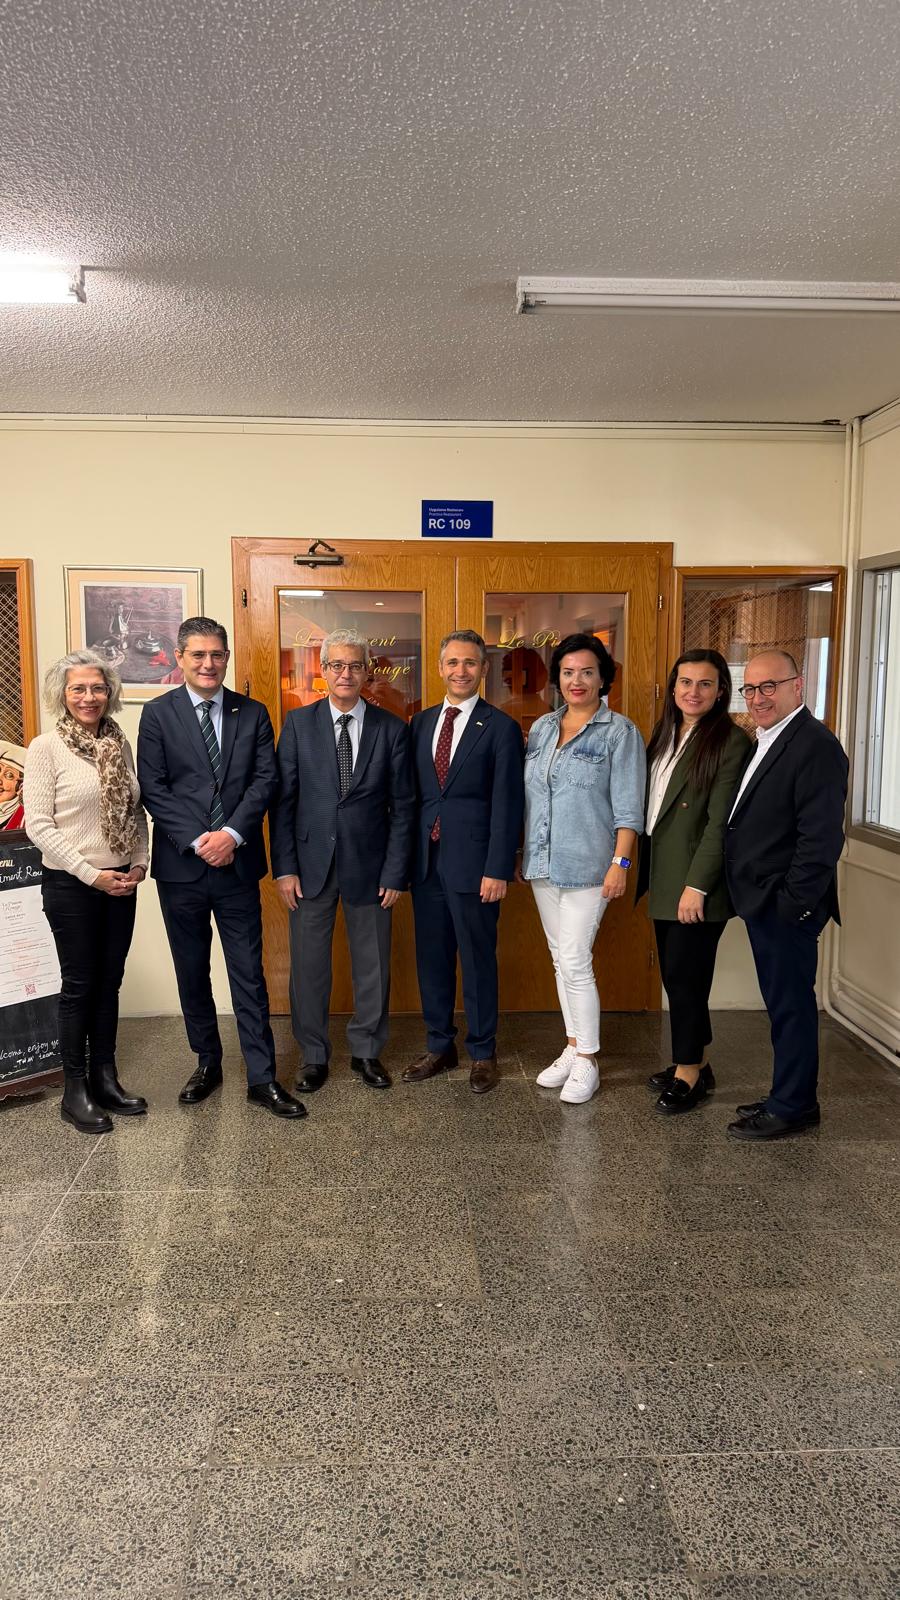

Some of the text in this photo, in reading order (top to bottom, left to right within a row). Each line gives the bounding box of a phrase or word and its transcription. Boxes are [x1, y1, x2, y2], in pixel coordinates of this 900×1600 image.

[428, 518, 471, 530] RC 109
[496, 629, 562, 649] Le Pi
[0, 859, 15, 868] enu
[25, 865, 43, 879] Rou
[28, 1042, 49, 1054] enjoy
